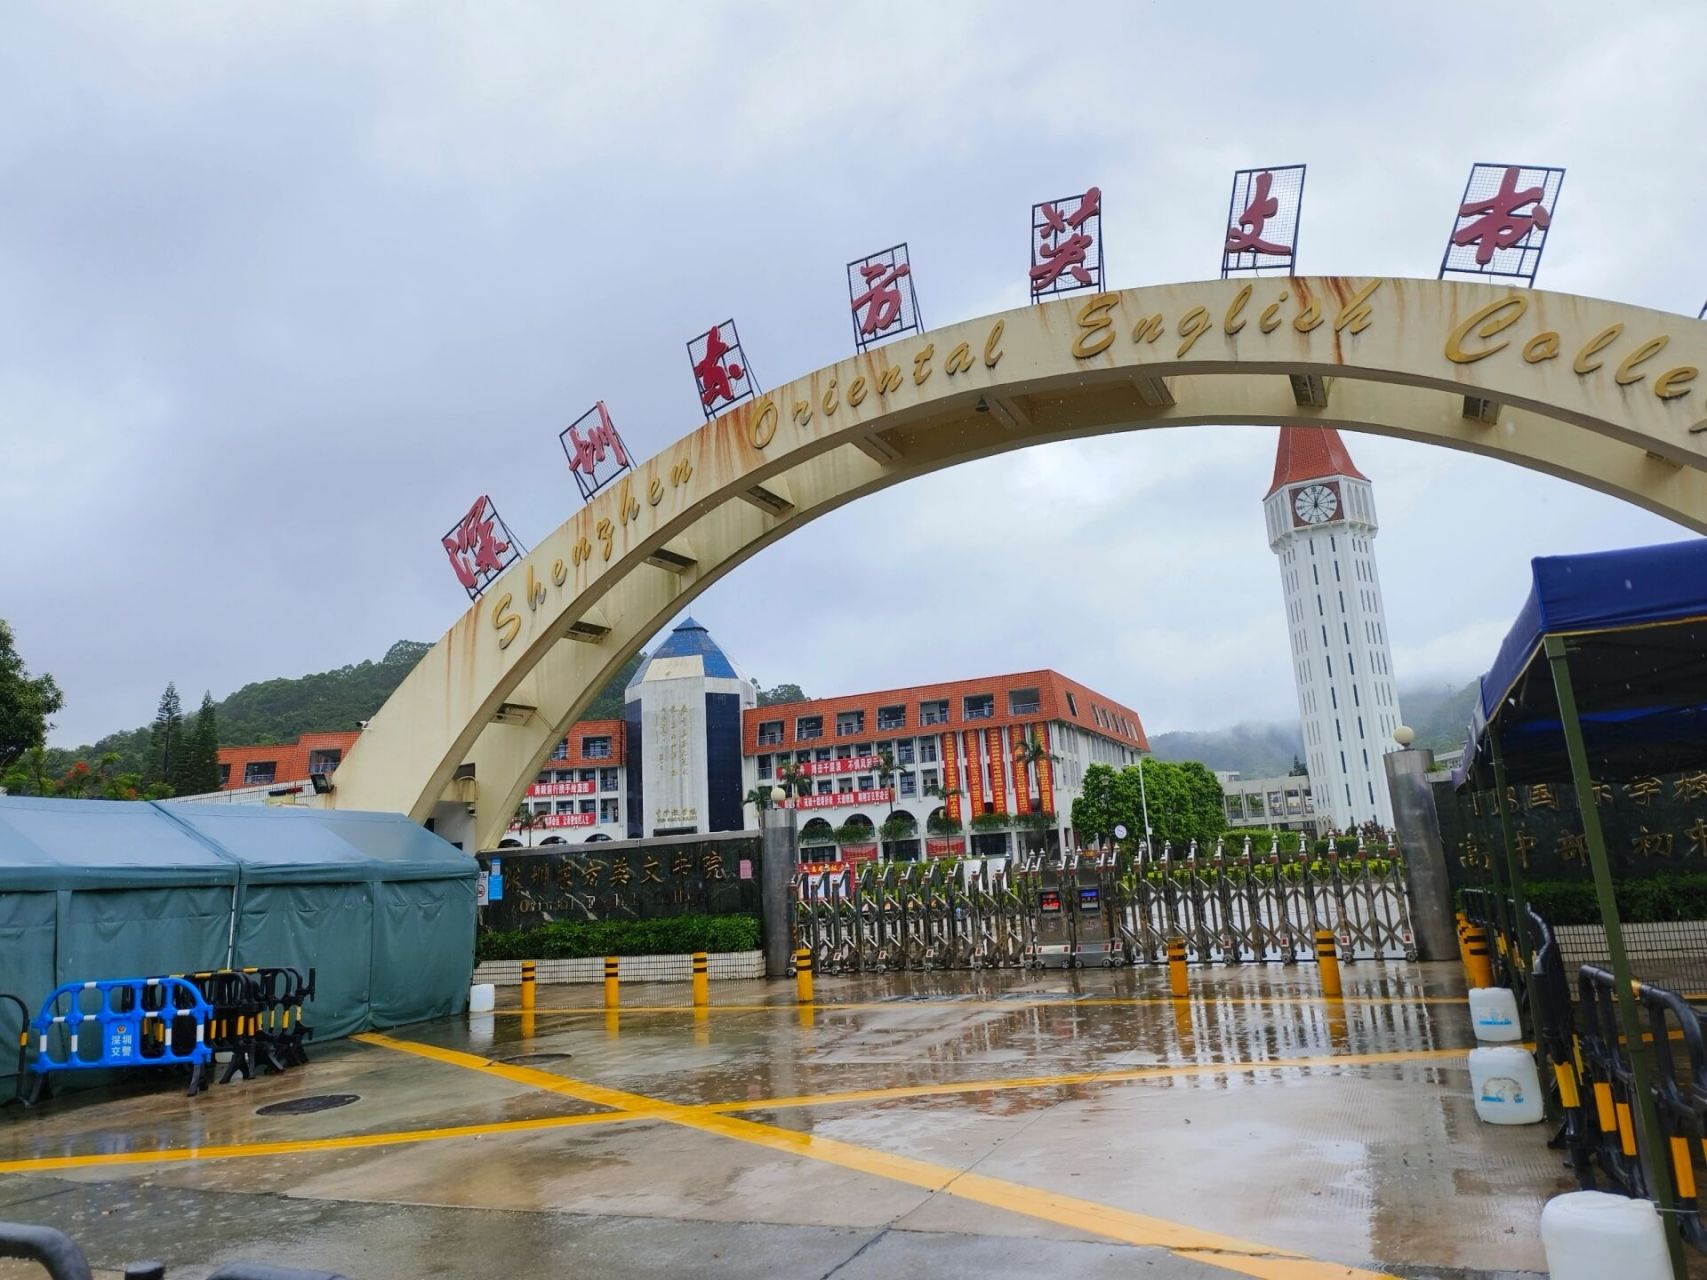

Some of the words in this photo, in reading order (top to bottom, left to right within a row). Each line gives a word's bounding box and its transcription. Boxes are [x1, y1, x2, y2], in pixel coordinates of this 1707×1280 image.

[491, 454, 693, 650] Shenzhen
[749, 319, 1005, 449] Oriental
[1072, 278, 1383, 359] English
[1445, 295, 1707, 434] Colle
[112, 1035, 132, 1045] 深圳
[112, 1046, 132, 1056] 交警
